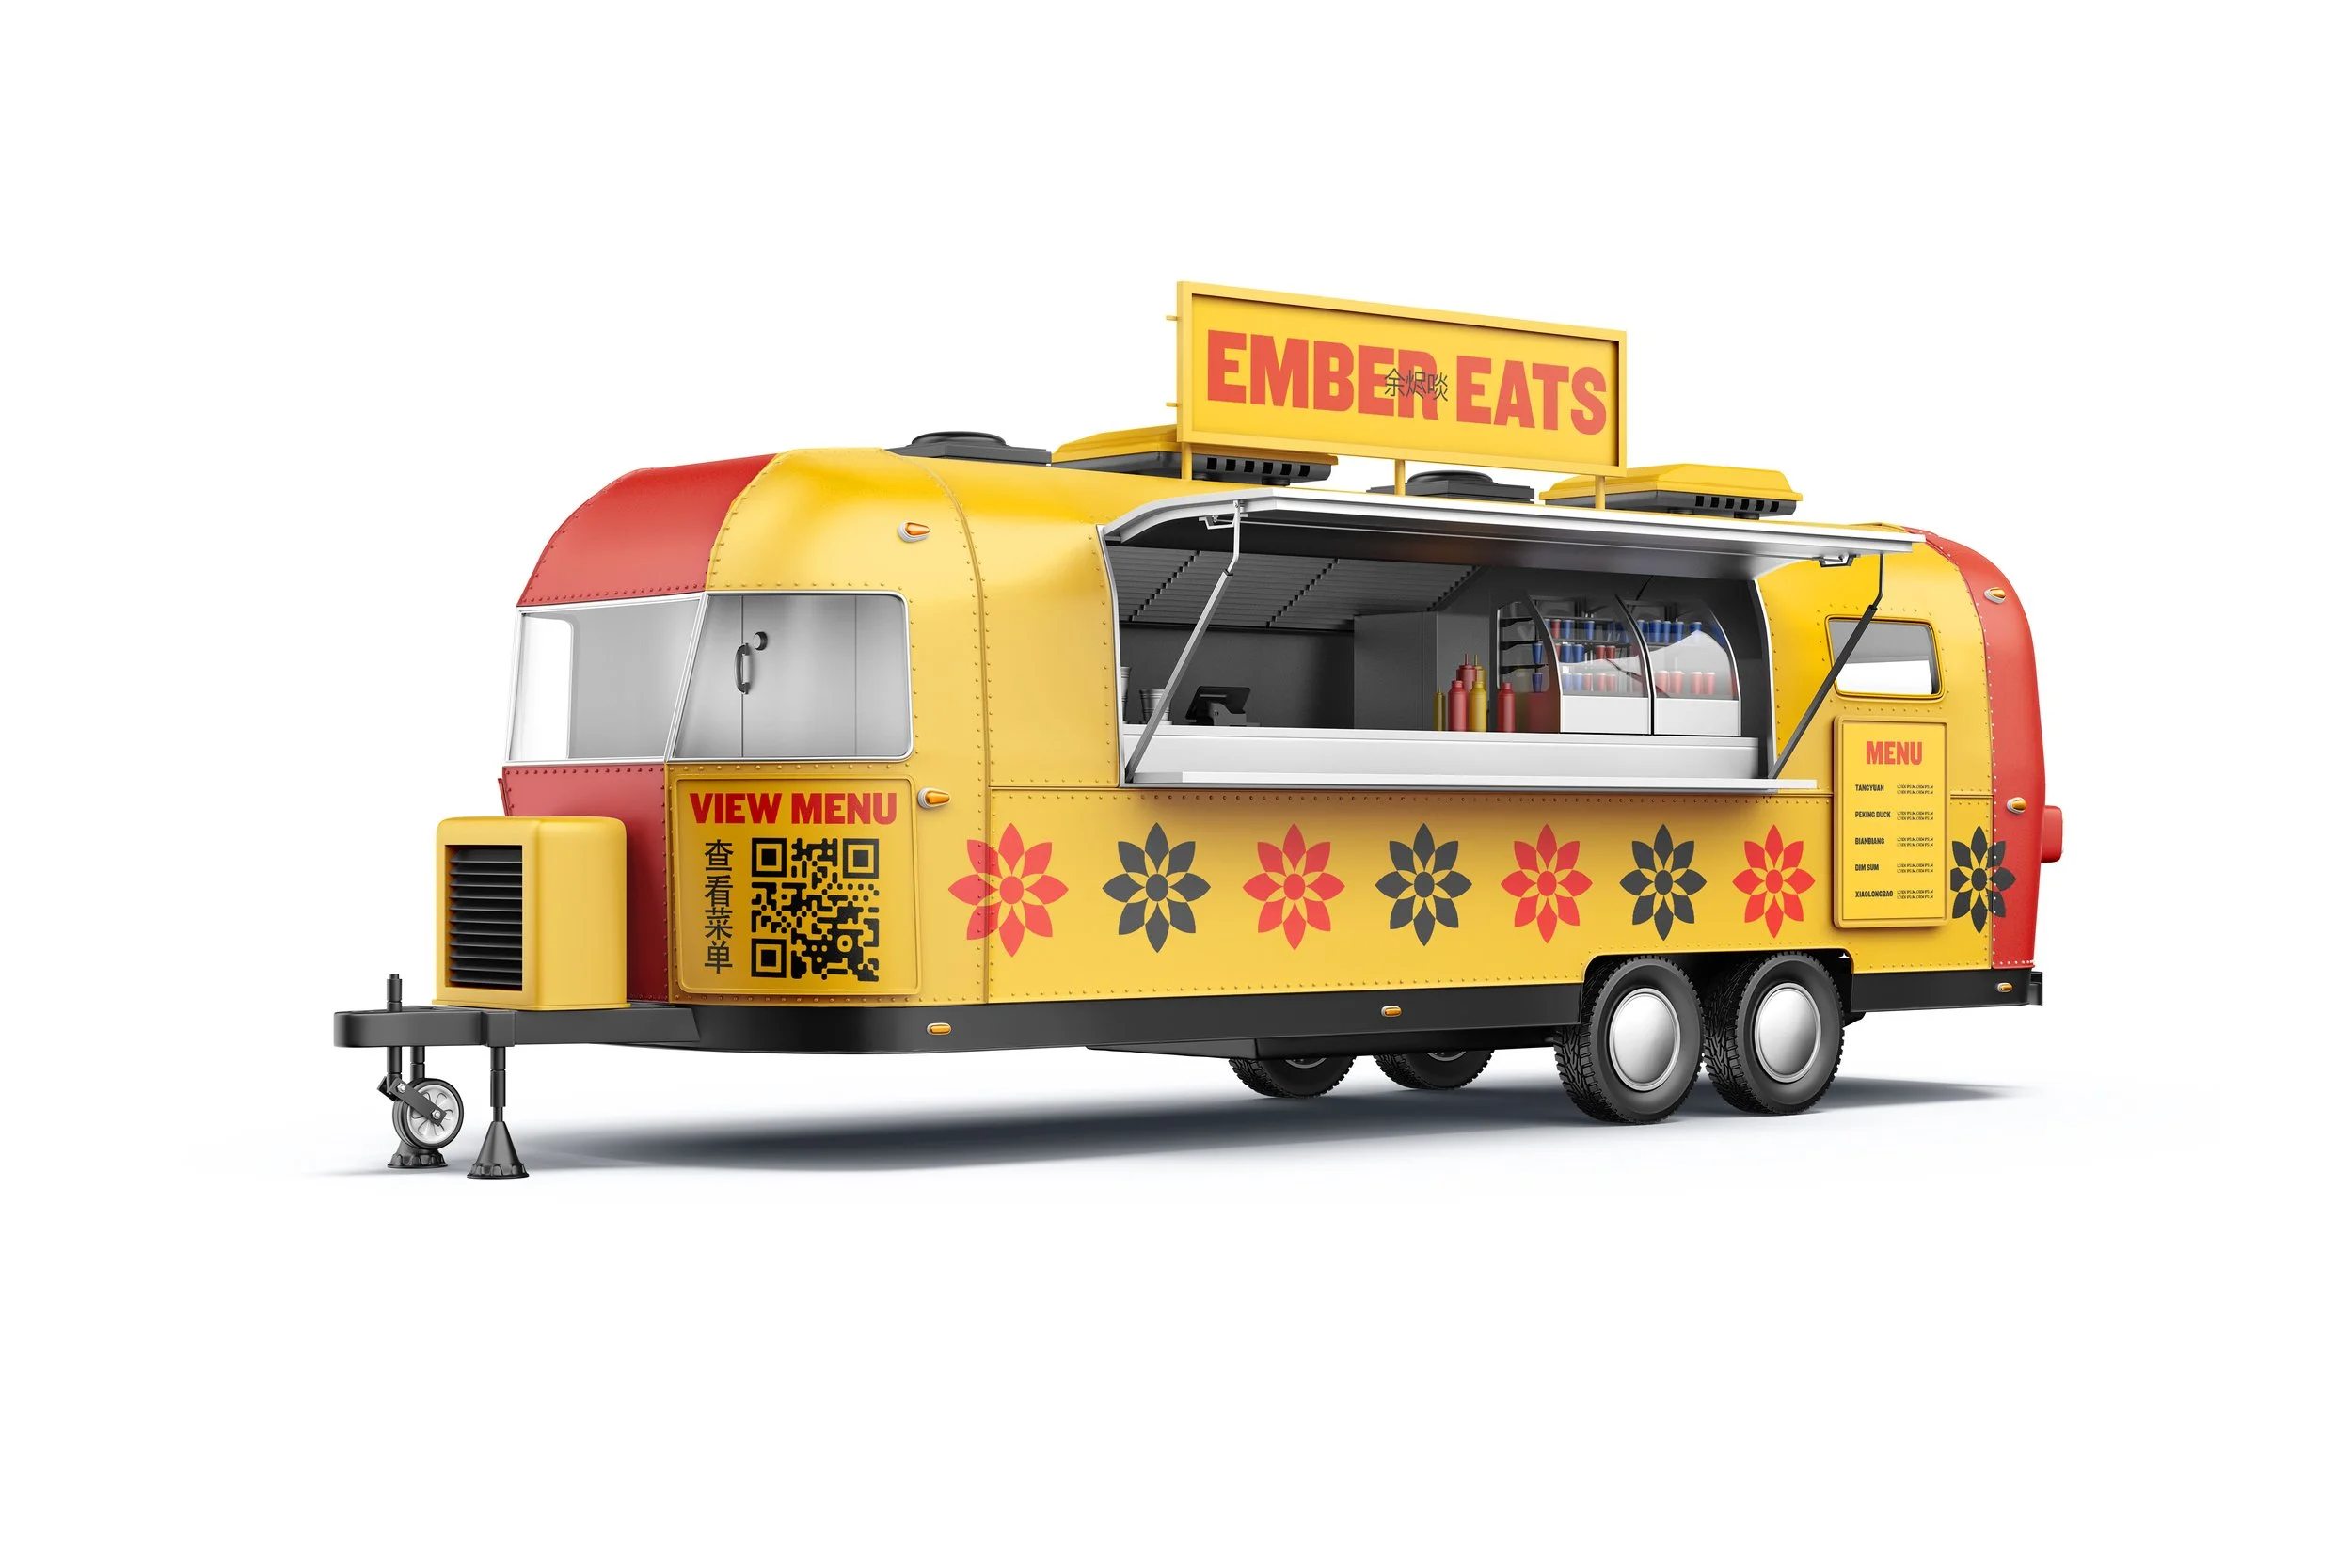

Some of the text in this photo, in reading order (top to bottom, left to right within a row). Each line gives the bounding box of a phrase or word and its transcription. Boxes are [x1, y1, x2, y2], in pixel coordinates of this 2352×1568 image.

[1208, 329, 1607, 436] EMBER EATS
[1384, 368, 1449, 402] 余烬啖
[1866, 740, 1923, 766] MENU
[690, 792, 897, 825] VIEW MENU
[704, 839, 734, 974] 查看菜单
